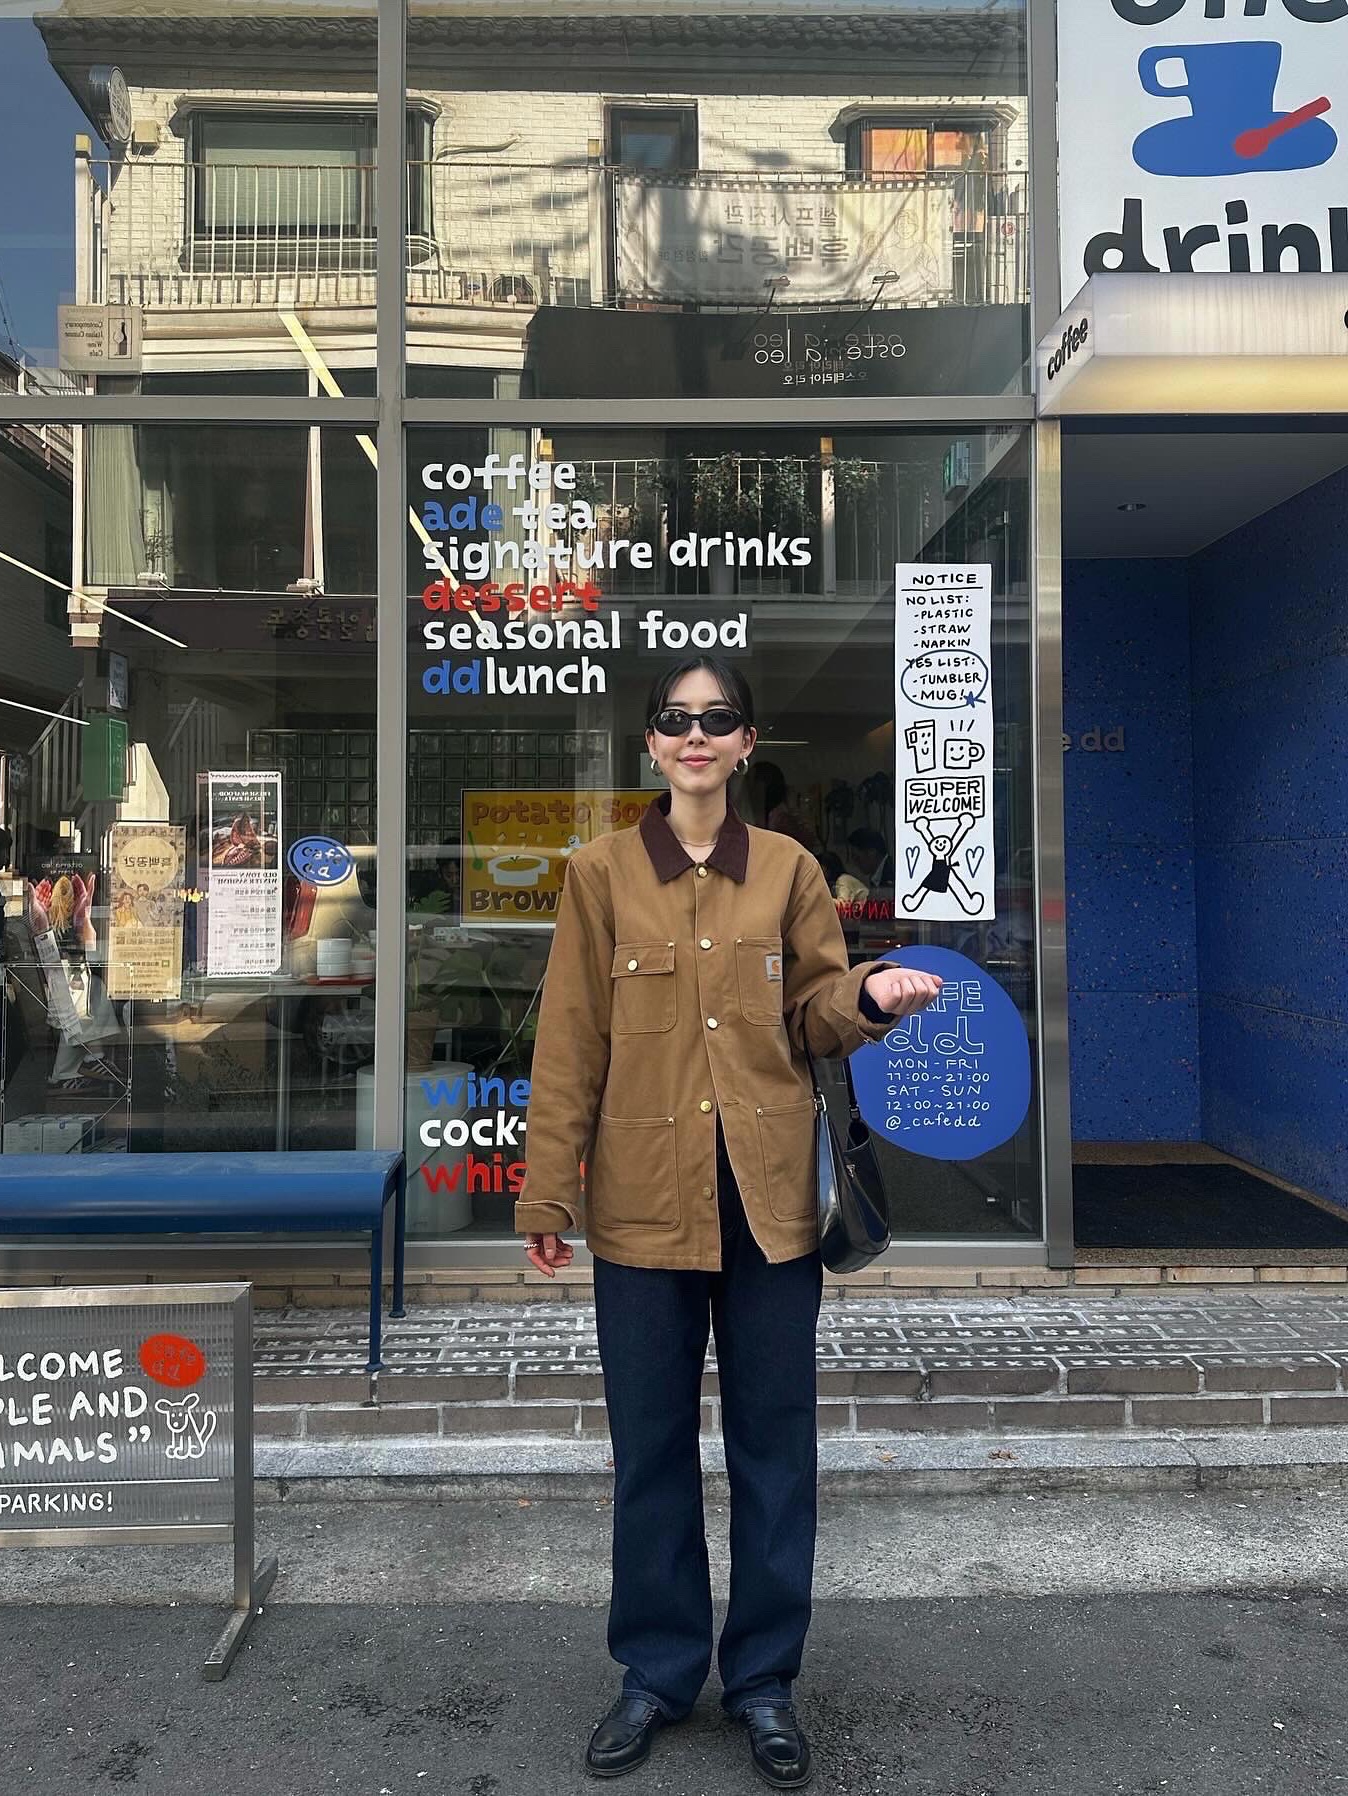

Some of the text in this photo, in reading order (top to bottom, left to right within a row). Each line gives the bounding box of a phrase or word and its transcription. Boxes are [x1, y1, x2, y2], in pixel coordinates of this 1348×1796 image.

[1083, 198, 1348, 273] drin
[1047, 316, 1089, 381] coffee
[421, 454, 577, 490] coffee
[422, 496, 597, 532] ade tea
[422, 532, 812, 581] signature drinks
[421, 577, 604, 612] dessert
[912, 573, 977, 586] NOTICE
[906, 595, 970, 606] NO LIST:
[422, 611, 621, 650] seasonal
[639, 610, 748, 649] food
[905, 656, 976, 669] YES LIST:
[1080, 724, 1125, 752] dd
[909, 780, 981, 797] SUPER
[601, 799, 646, 825] So
[909, 796, 981, 815] WELCOME
[470, 887, 566, 913] Brow
[884, 1014, 985, 1055] dd
[888, 1059, 929, 1069] MON
[946, 1059, 979, 1069] FRI
[420, 1072, 533, 1109] wine
[886, 1085, 920, 1096] SAT
[941, 1085, 981, 1096] SUN
[420, 1152, 528, 1194] whis
[69, 1386, 148, 1422] AND
[0, 1491, 113, 1514] PARKING!
